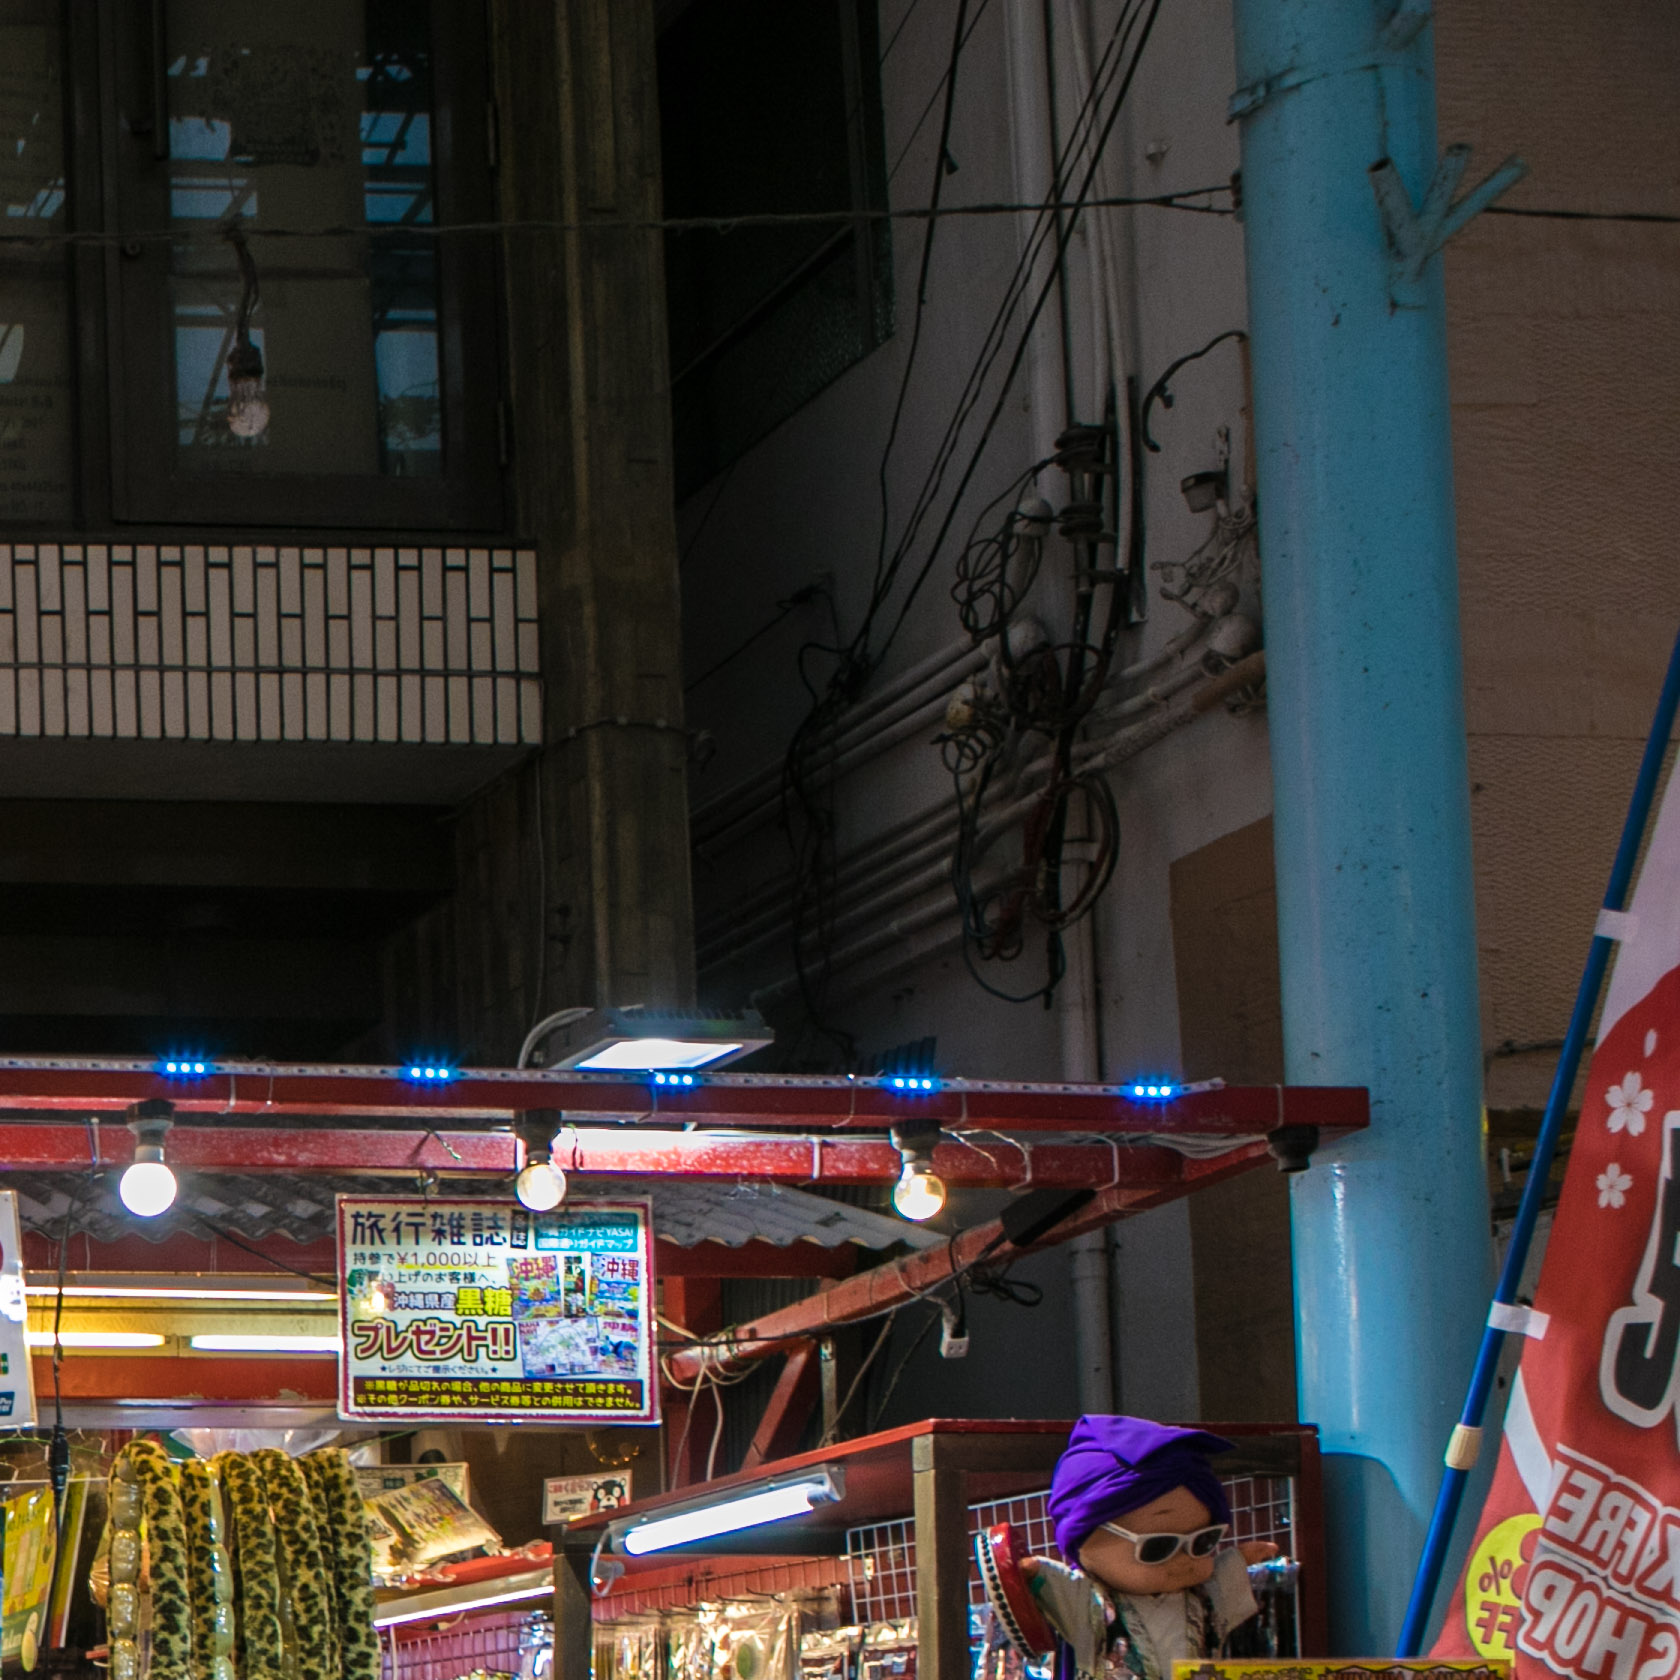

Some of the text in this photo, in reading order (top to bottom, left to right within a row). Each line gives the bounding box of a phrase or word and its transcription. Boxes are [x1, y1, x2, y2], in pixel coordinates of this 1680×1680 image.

[351, 1211, 507, 1246] 旅行雑誌
[601, 1258, 639, 1280] 沖縄
[352, 1319, 516, 1361] プレゼント!!
